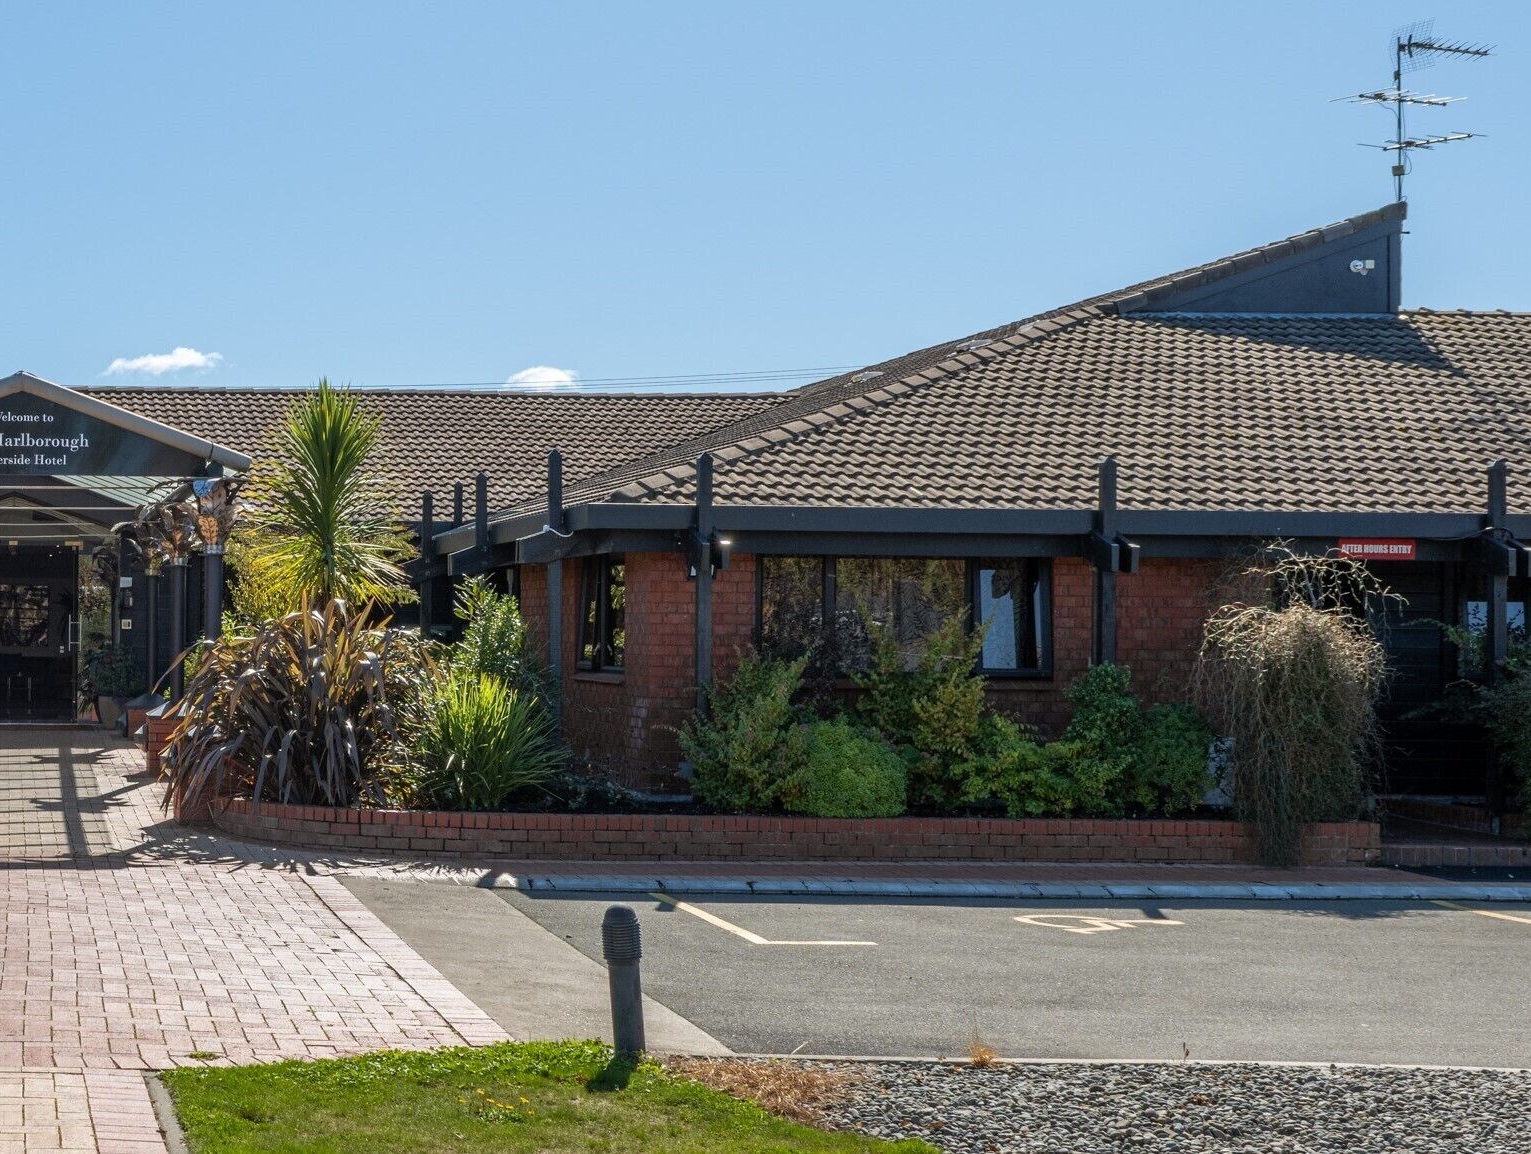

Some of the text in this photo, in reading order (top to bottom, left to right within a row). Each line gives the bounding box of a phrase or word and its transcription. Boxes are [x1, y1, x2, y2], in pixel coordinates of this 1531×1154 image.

[43, 413, 54, 422] to
[34, 454, 67, 465] Hotel
[1341, 544, 1413, 554] AFTER HOURS ENTRY
